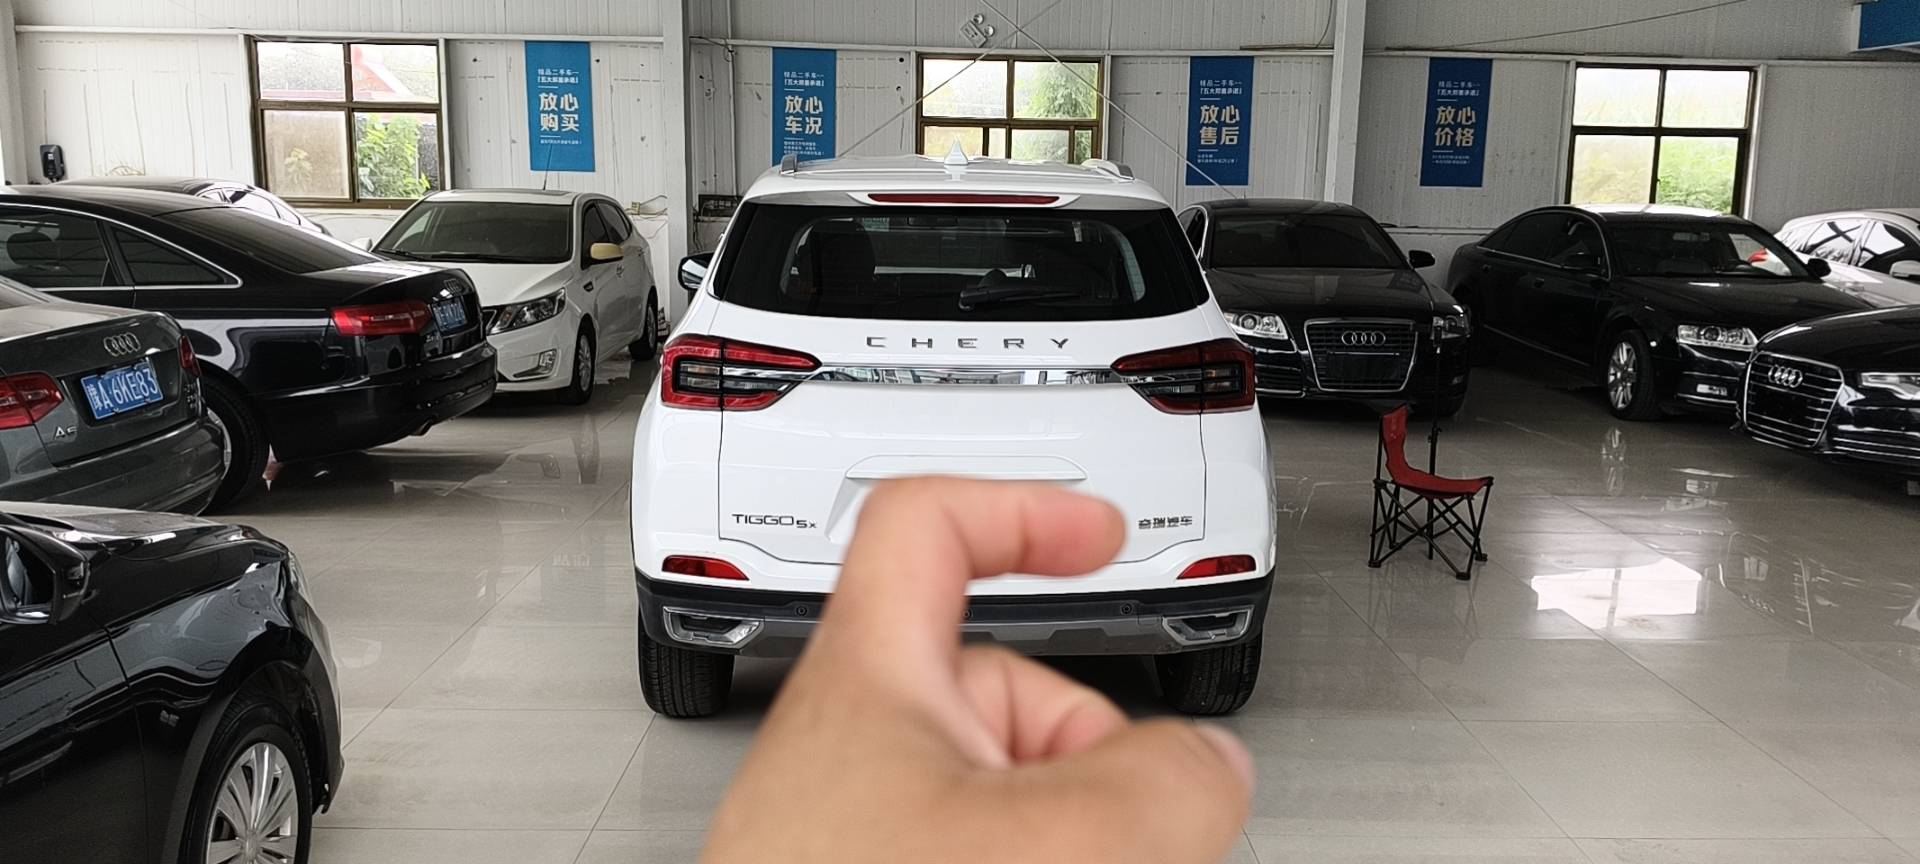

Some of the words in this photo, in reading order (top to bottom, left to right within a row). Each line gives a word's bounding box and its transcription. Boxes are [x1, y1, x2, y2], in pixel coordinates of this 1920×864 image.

[539, 92, 579, 111] 放心
[784, 95, 823, 114] 放心
[540, 113, 580, 132] 购买
[1200, 104, 1240, 124] 放心
[1435, 105, 1476, 125] 放心
[784, 115, 823, 135] 车况
[1200, 126, 1240, 145] 售后
[1435, 127, 1475, 147] 价格
[866, 336, 1069, 350] CHERY
[731, 513, 794, 526] TIGGO
